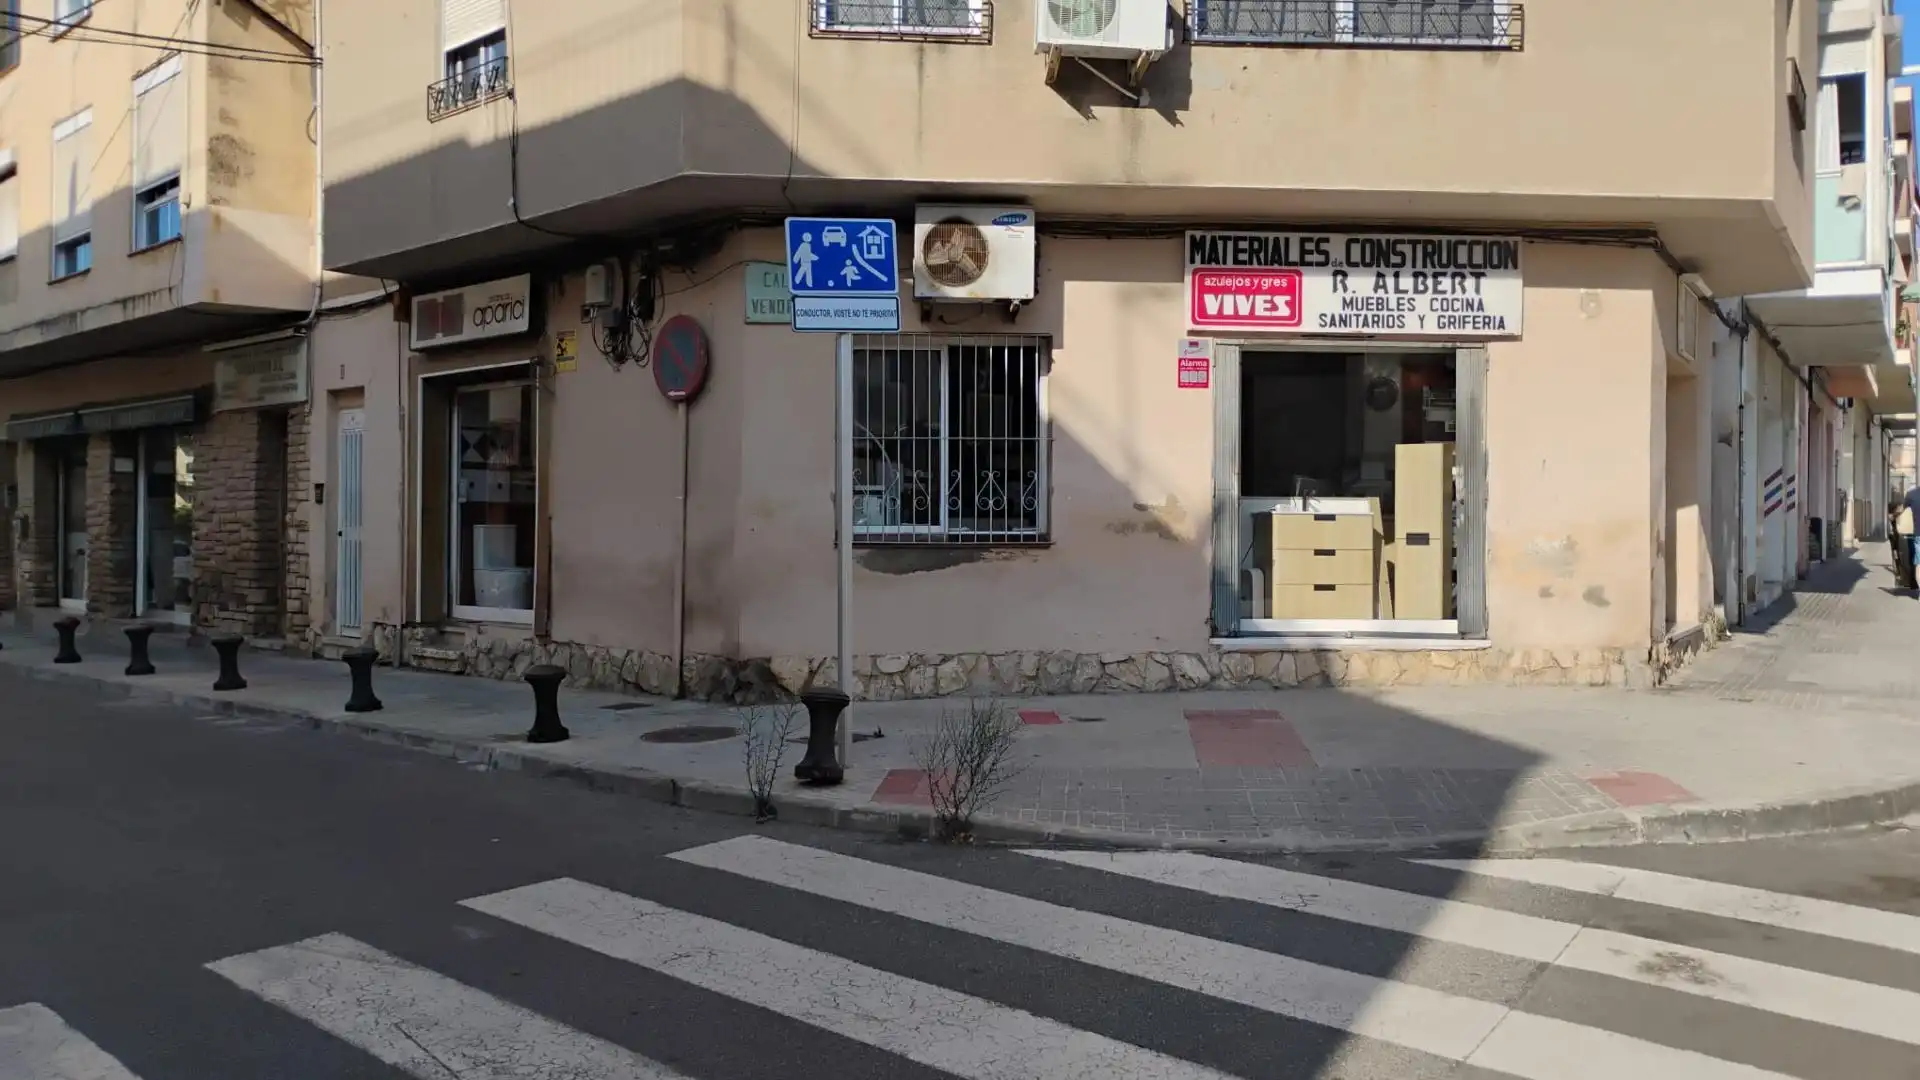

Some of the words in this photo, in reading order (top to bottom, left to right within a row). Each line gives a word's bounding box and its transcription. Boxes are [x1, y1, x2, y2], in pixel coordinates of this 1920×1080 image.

[1189, 235, 1330, 268] MATERIALES
[1331, 258, 1344, 268] de
[1345, 238, 1519, 271] CONSTRUCCION
[763, 272, 788, 289] CAL
[1204, 275, 1251, 291] azulejos
[1252, 278, 1259, 291] y
[1260, 277, 1288, 291] gres
[1332, 270, 1356, 294] R.
[1373, 271, 1488, 295] ALBERT
[473, 295, 525, 331] aparici
[1203, 294, 1291, 317] VIVES
[1342, 297, 1416, 312] MUEBLES
[1430, 297, 1485, 313] COCINA
[1319, 314, 1406, 330] SANITARIOS
[1418, 315, 1427, 330] Y
[1437, 315, 1506, 331] GRIFERIA
[1180, 359, 1208, 367] Alarma
